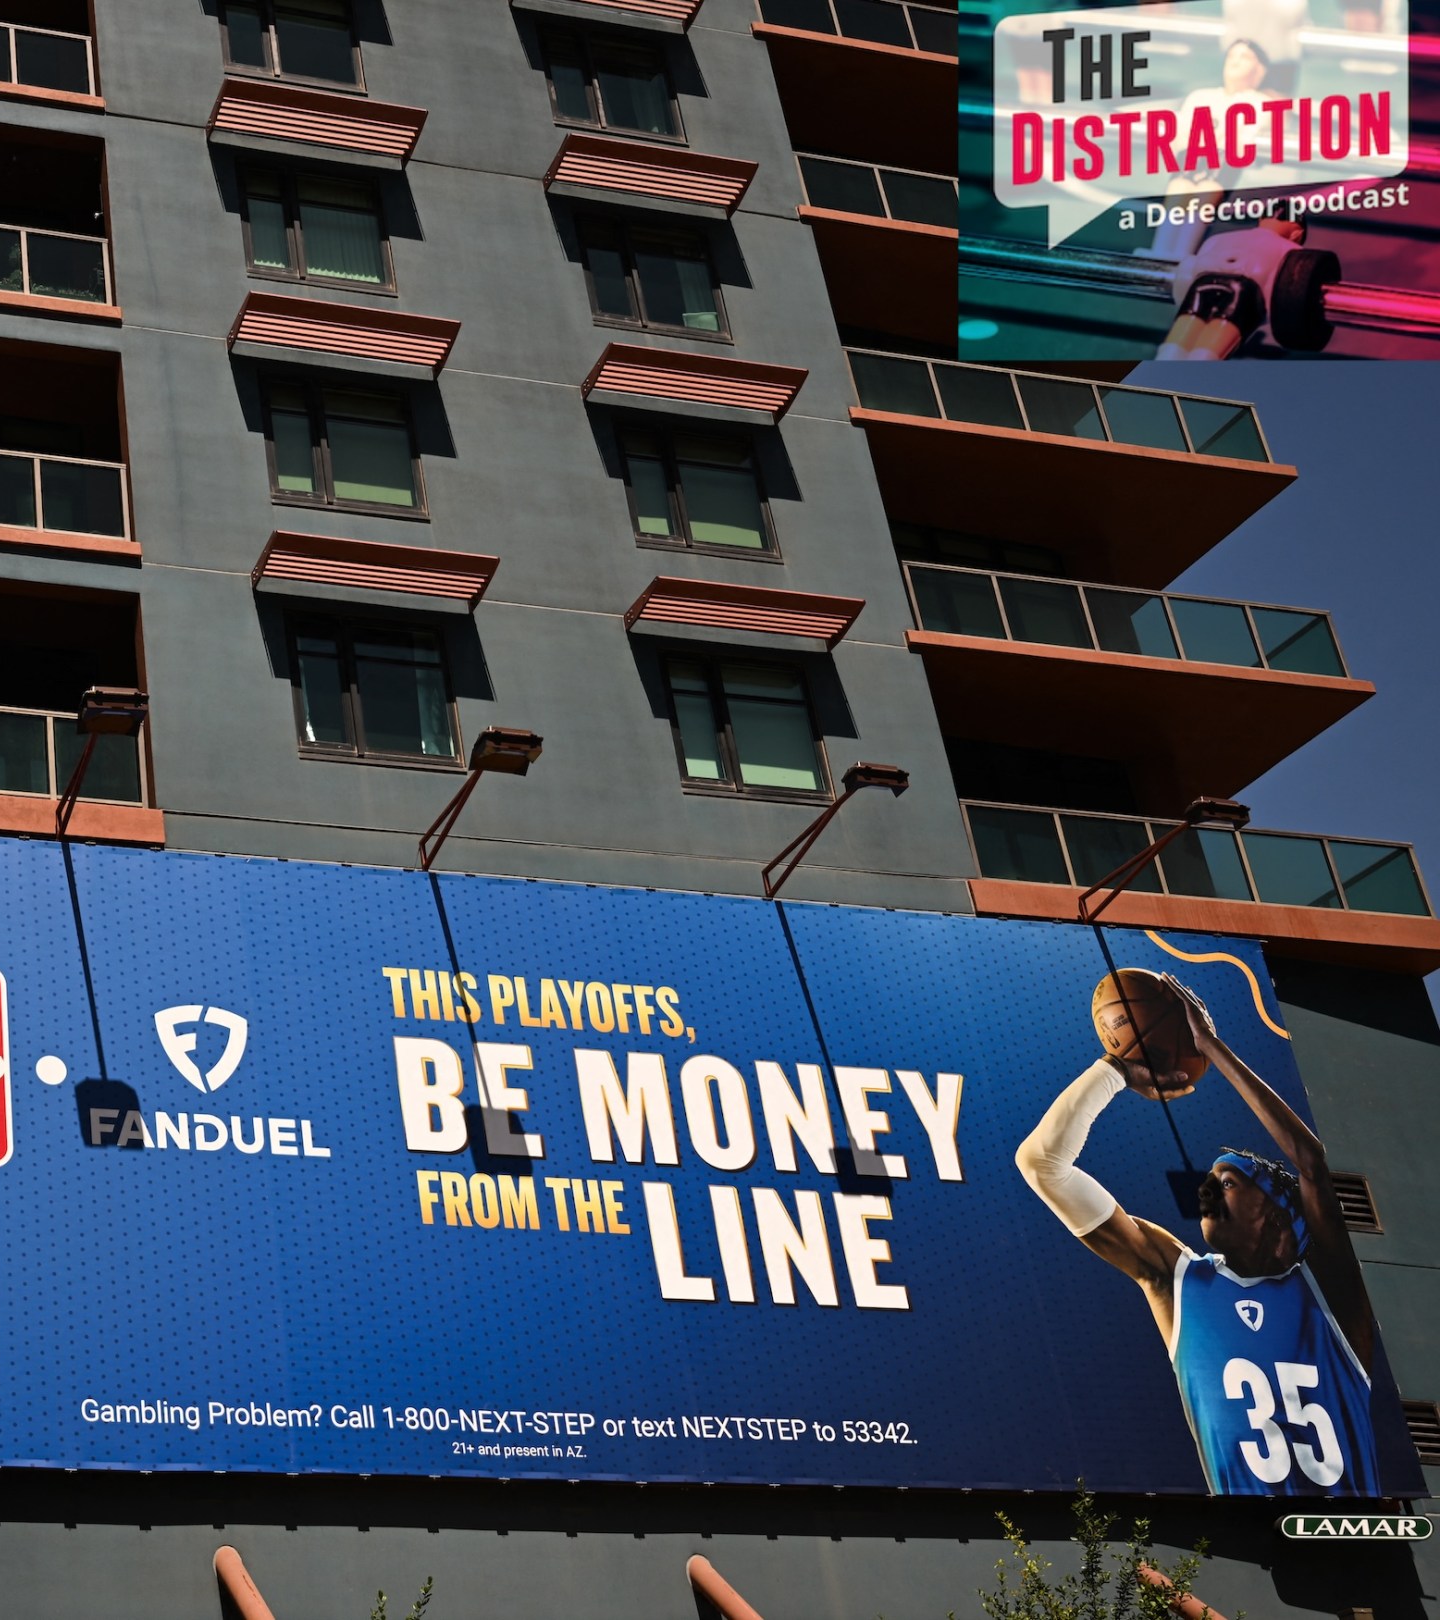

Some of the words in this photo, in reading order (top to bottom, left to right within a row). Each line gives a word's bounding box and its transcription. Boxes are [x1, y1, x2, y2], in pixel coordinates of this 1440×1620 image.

[382, 967, 482, 1024] THIS
[488, 974, 697, 1044] PLAYOFFS,
[89, 1107, 331, 1157] FANDUEL
[393, 1036, 545, 1160] BE
[573, 1048, 965, 1183] MONEY
[416, 1170, 540, 1231] FROM
[545, 1177, 631, 1235] THE
[642, 1181, 911, 1311] LINE
[81, 1398, 201, 1430] Gambling
[208, 1402, 322, 1428] Problem?
[330, 1405, 375, 1429] Call
[382, 1407, 596, 1436] 1-800-NEXT-STEP
[603, 1418, 626, 1437] or
[632, 1416, 677, 1439] text
[681, 1416, 808, 1442] NEXTSTEP
[813, 1421, 836, 1442] to
[842, 1420, 919, 1445] 53342.
[452, 1442, 475, 1455] 21+
[478, 1443, 501, 1456] and
[504, 1445, 550, 1459] present
[552, 1444, 563, 1457] in
[566, 1445, 587, 1458] AZ.
[1222, 1357, 1345, 1487] 35
[1296, 1518, 1418, 1536] LAMAR
